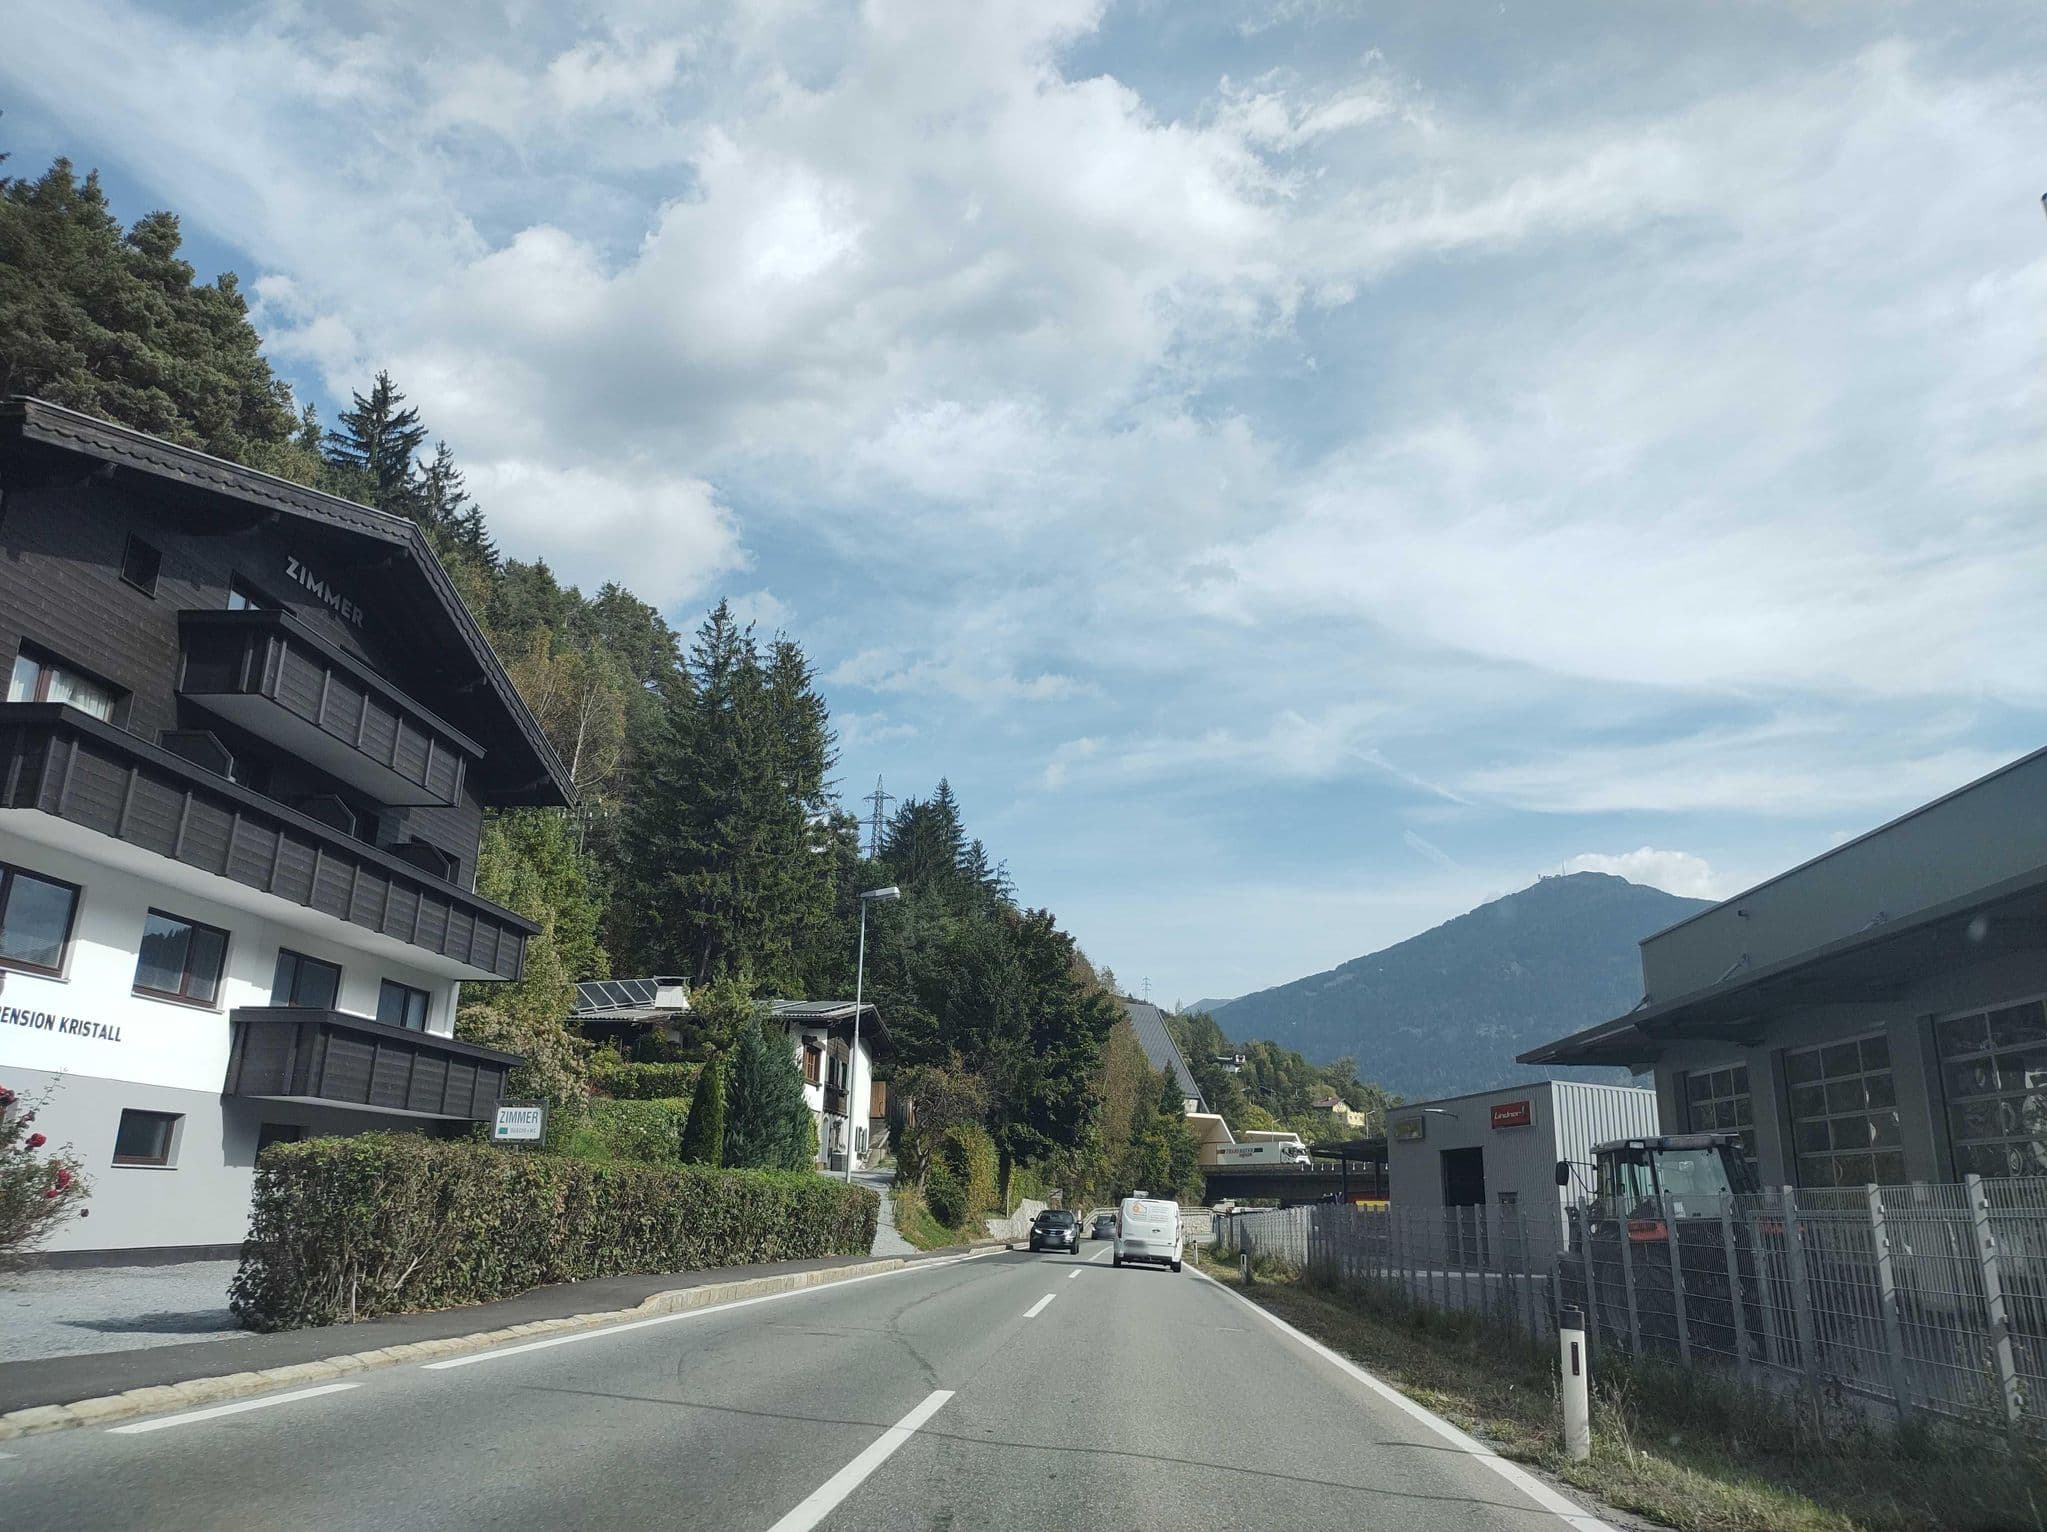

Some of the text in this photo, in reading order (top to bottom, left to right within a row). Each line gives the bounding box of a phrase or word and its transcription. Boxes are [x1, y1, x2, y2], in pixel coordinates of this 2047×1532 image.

[286, 555, 363, 628] ZIMMER
[0, 1006, 121, 1042] ENSION KRISTALL
[499, 1110, 539, 1124] ZIMMER
